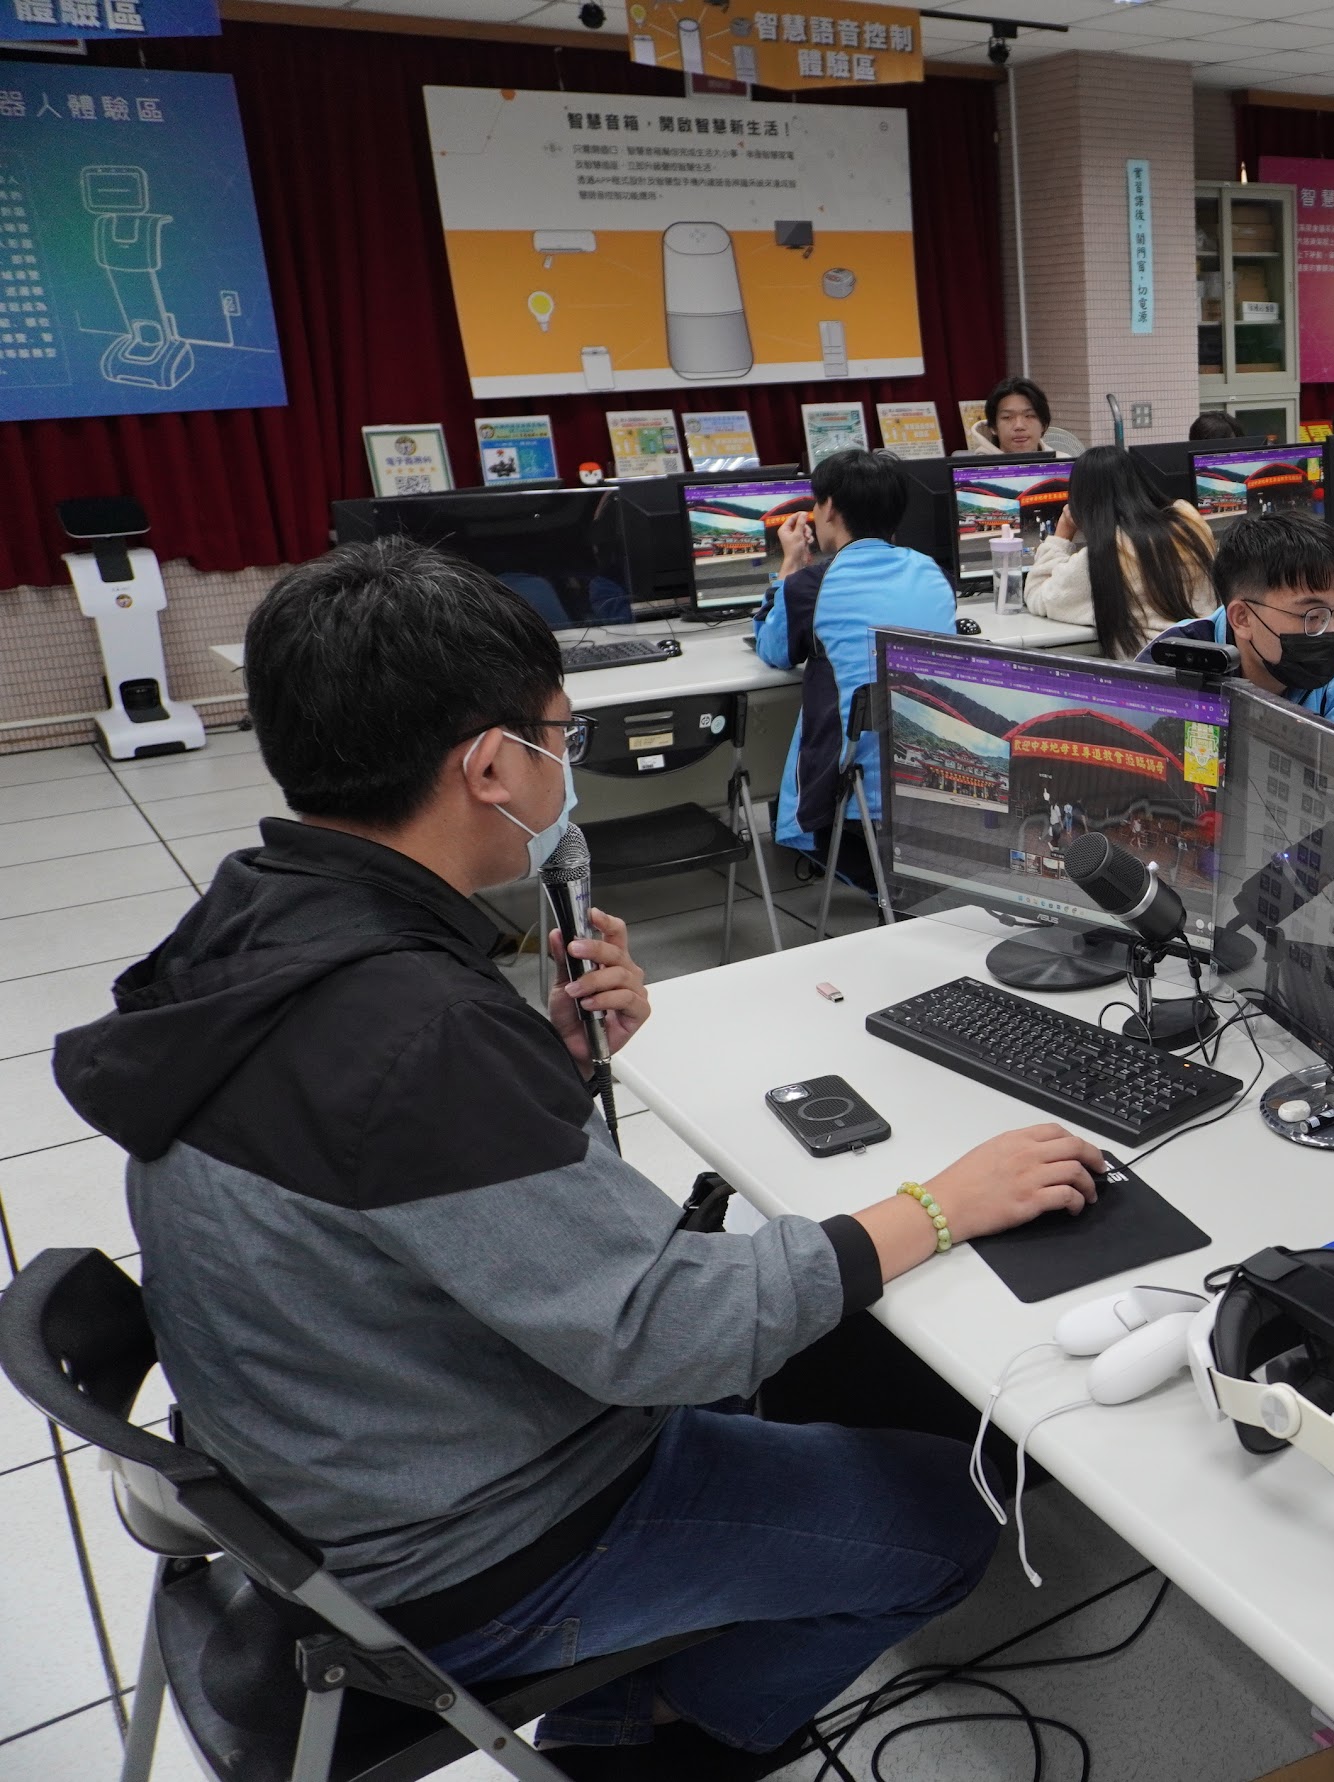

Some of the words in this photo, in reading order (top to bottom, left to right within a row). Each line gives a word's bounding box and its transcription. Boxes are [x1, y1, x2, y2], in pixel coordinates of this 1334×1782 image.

[754, 11, 914, 52] 智慧語音控制
[798, 49, 876, 81] 體驗區
[1036, 913, 1059, 924] ASUS
